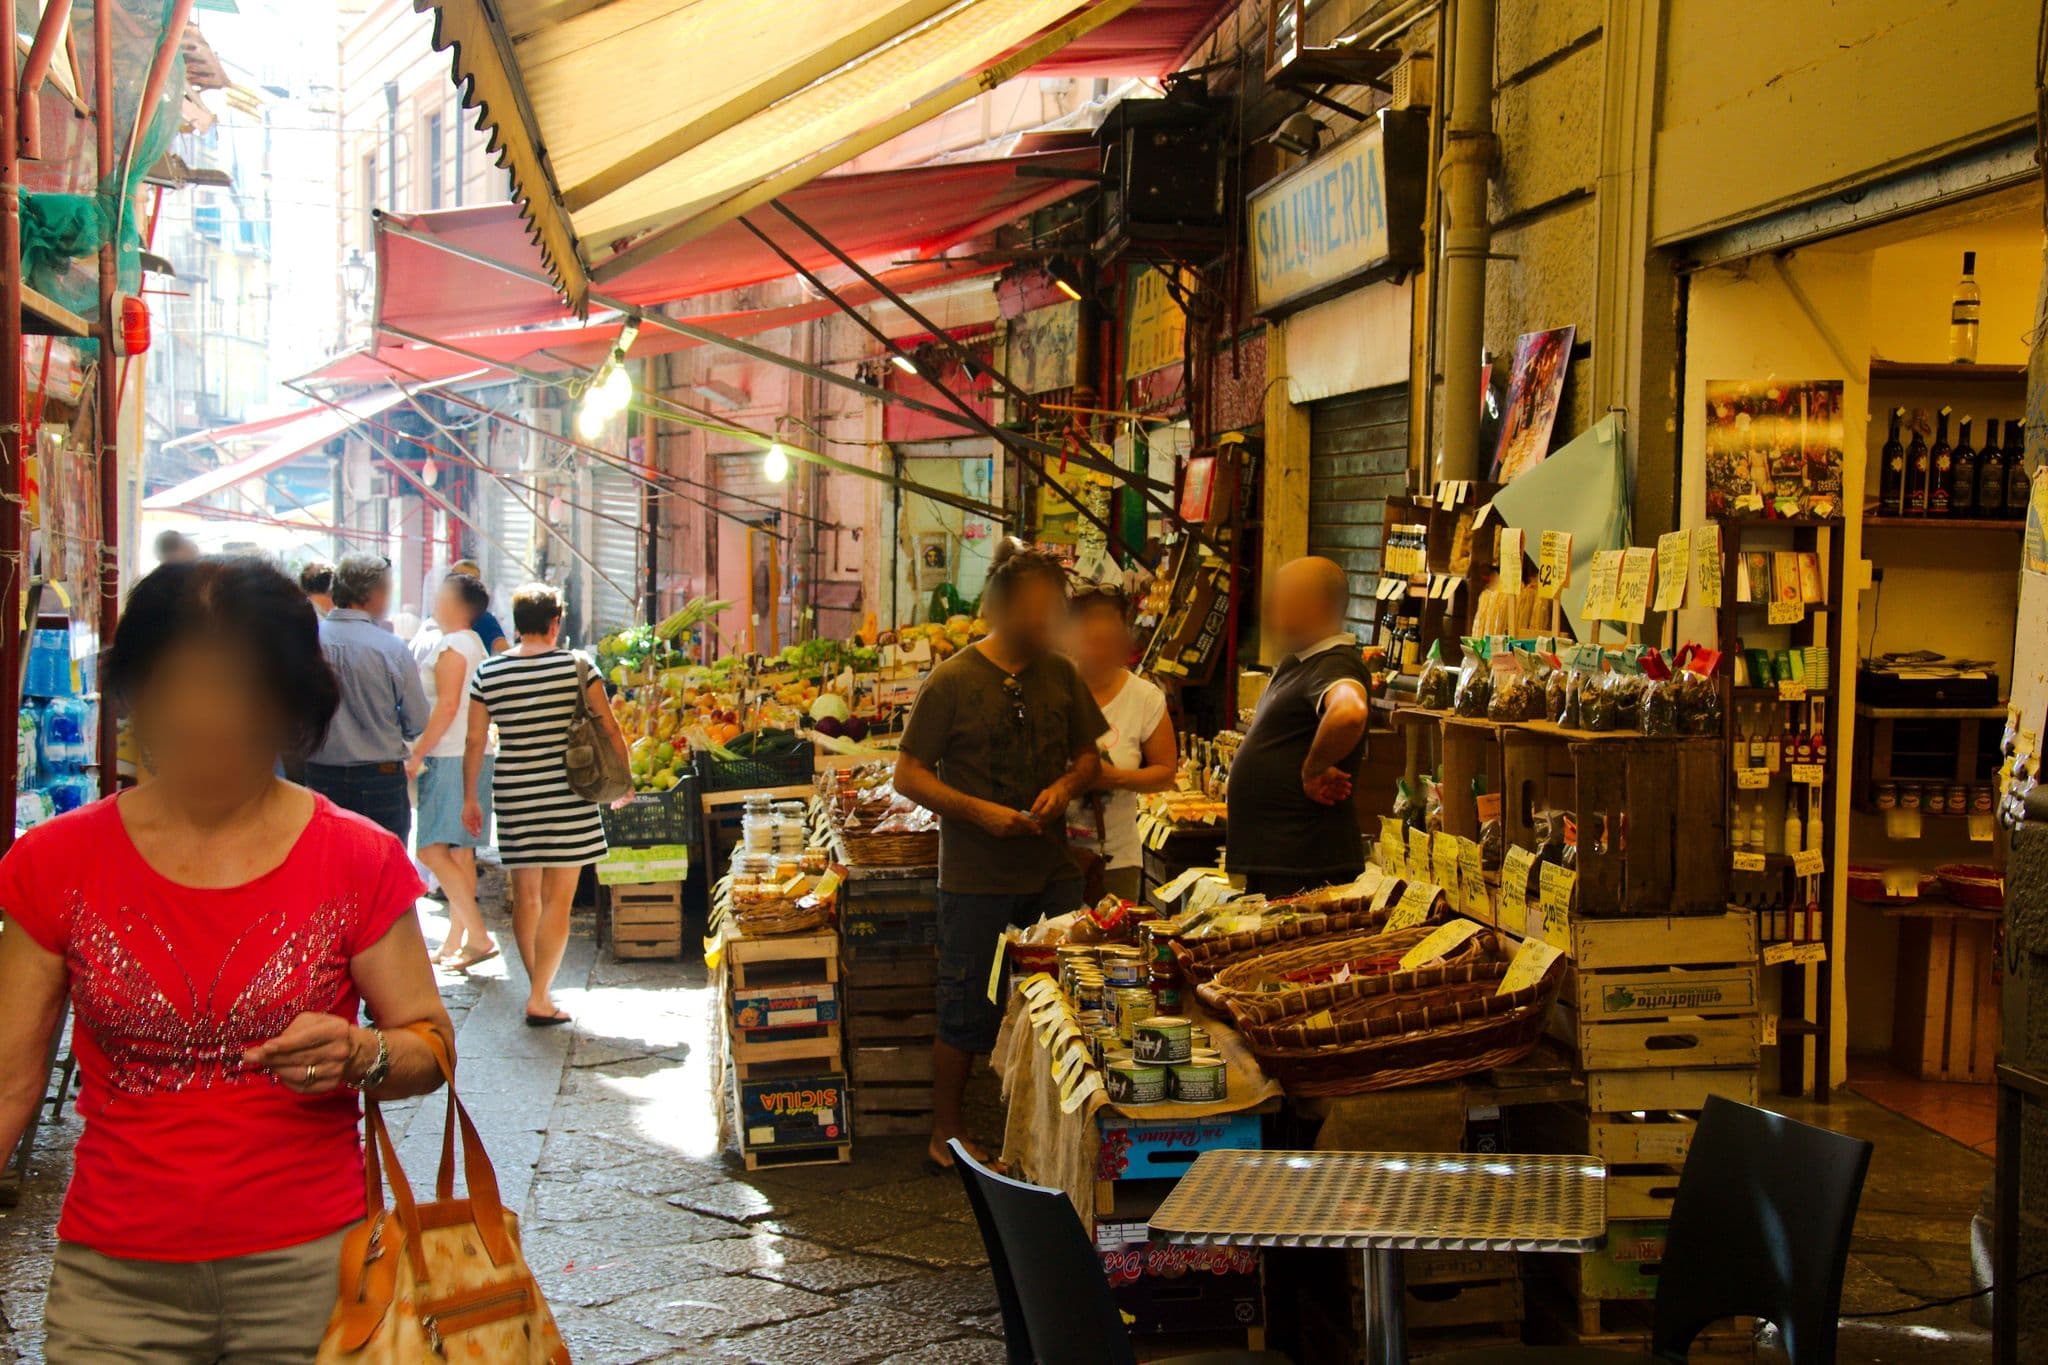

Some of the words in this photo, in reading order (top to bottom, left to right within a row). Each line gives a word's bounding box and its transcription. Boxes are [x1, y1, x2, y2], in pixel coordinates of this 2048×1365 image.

[1257, 147, 1385, 289] SALUMERIA
[1637, 992, 1722, 1009] emiliafrutta
[760, 1088, 838, 1111] SICILIA
